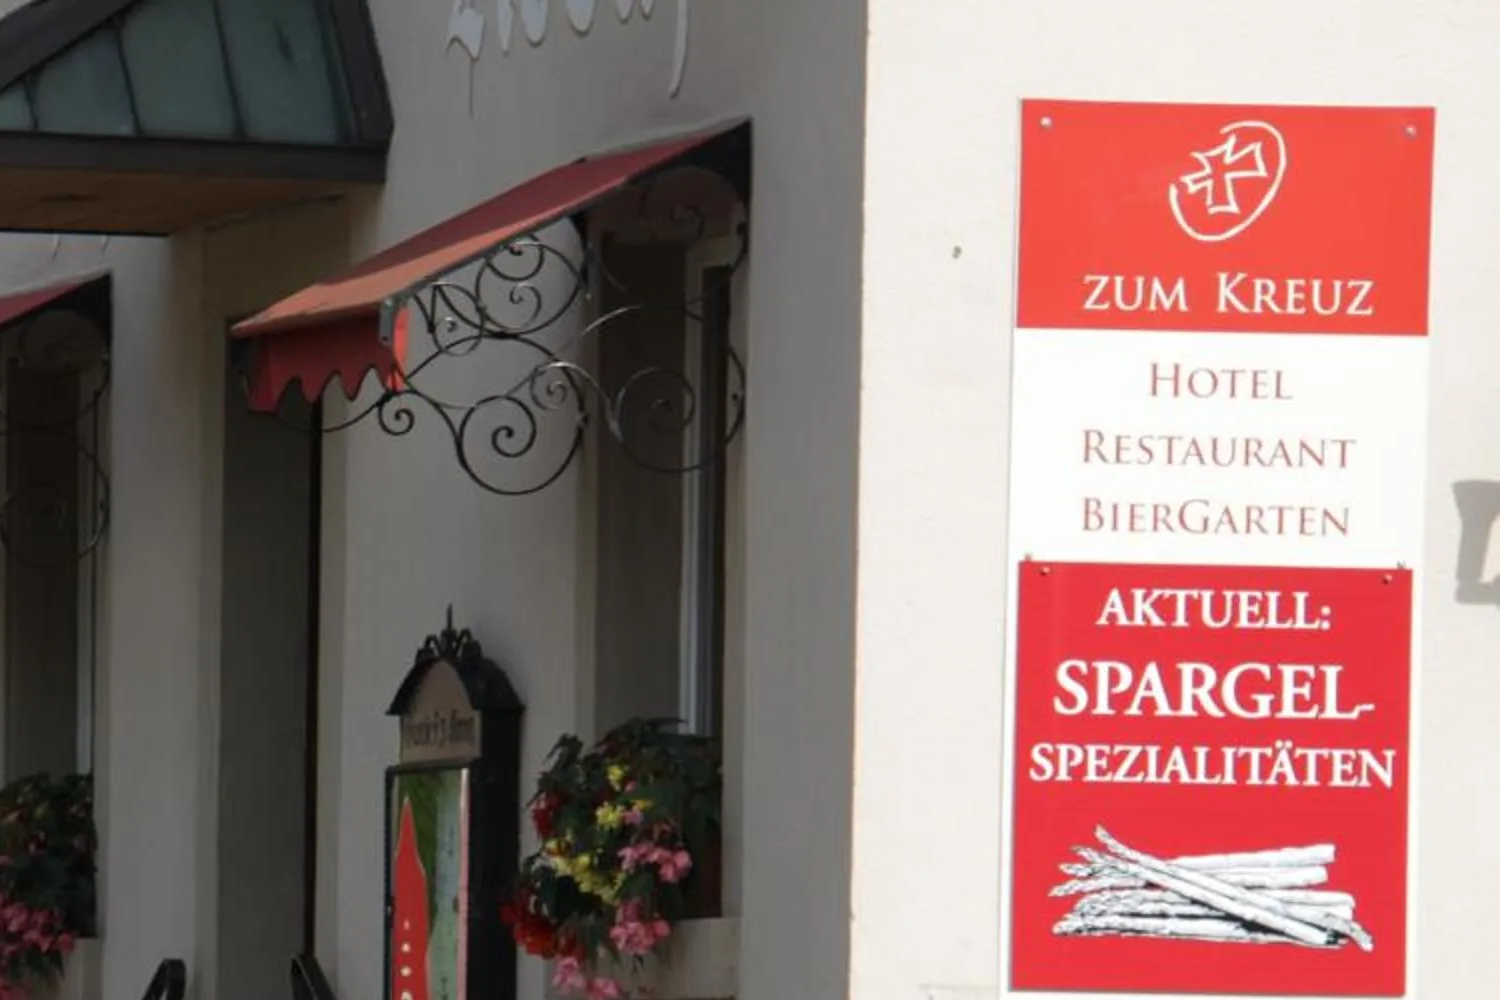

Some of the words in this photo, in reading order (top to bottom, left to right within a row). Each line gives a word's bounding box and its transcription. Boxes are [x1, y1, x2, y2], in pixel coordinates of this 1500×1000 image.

[1215, 271, 1375, 317] KREUZ
[1148, 362, 1294, 401] HOTEL
[1081, 429, 1358, 470] RESTAURANT
[1081, 497, 1351, 537] BIERGARTEN
[1095, 587, 1332, 631] AKTUELL:
[1052, 659, 1376, 720] SPARGEL-
[1028, 739, 1397, 789] SPEZIALITÄTEN
